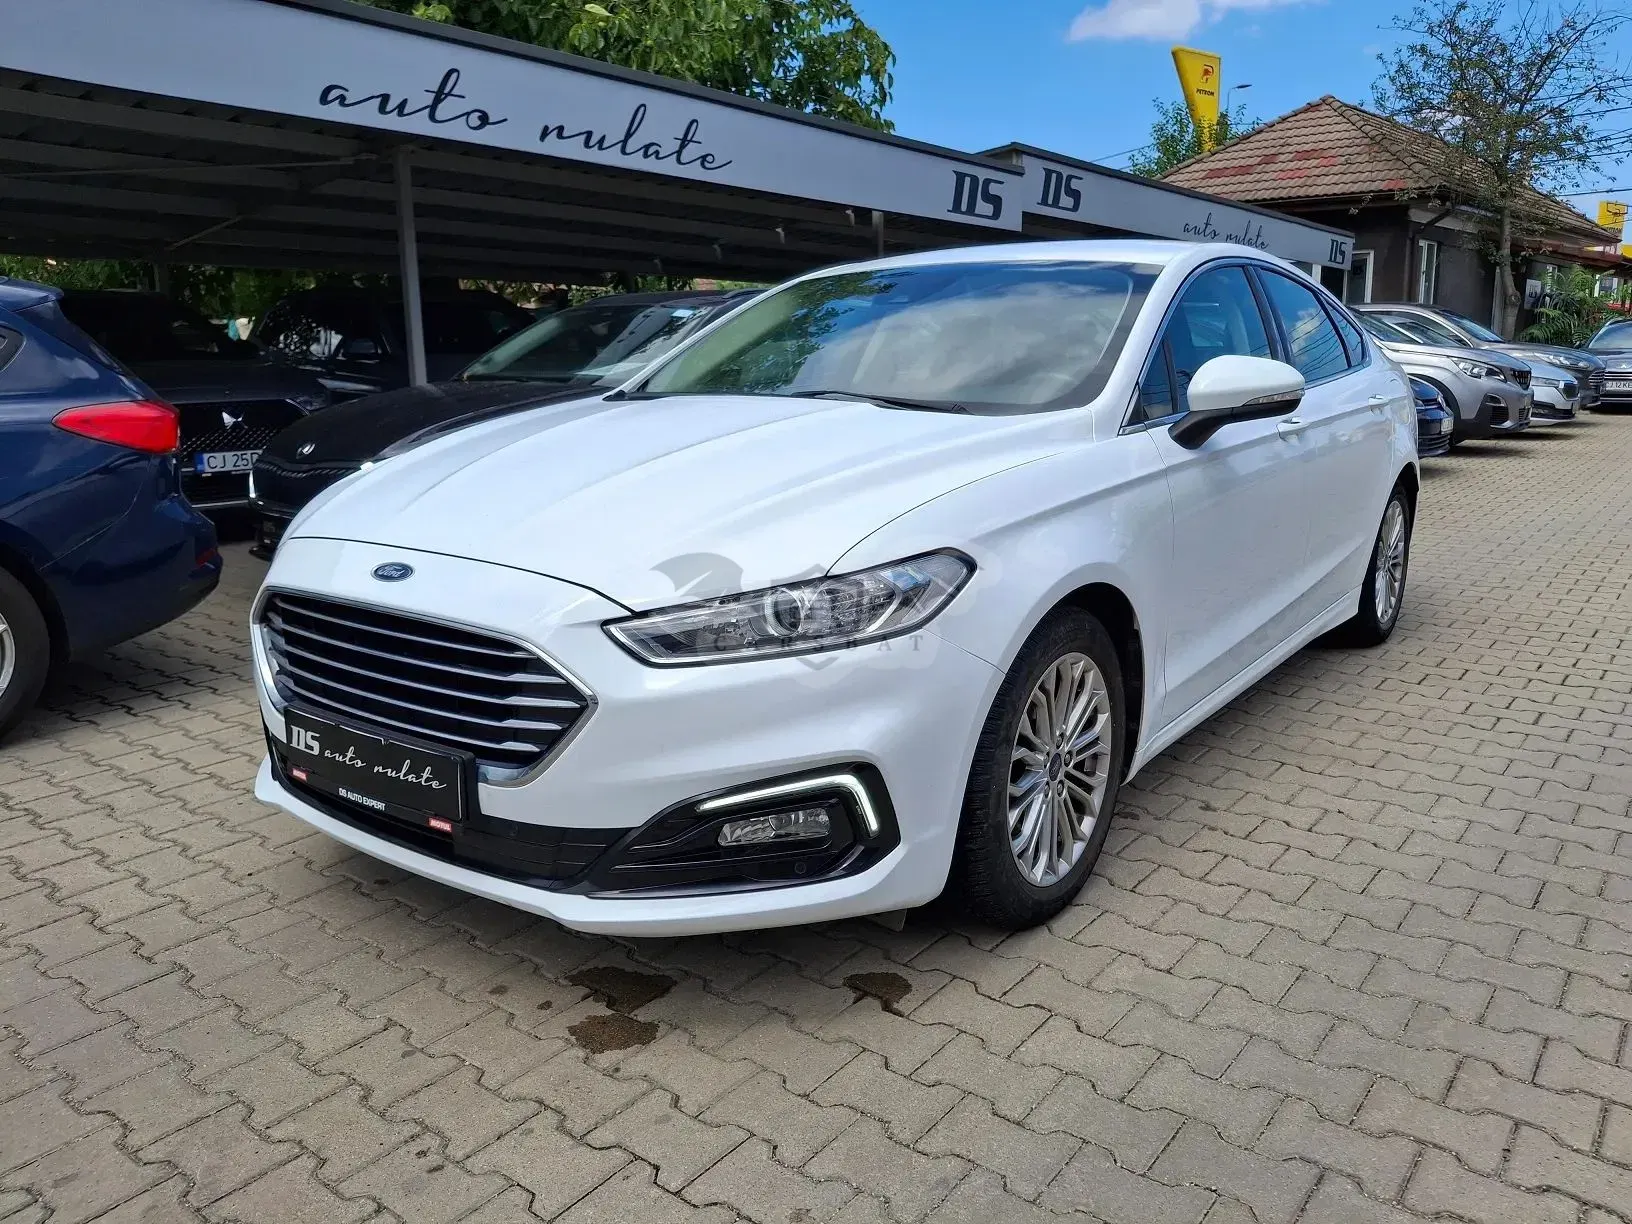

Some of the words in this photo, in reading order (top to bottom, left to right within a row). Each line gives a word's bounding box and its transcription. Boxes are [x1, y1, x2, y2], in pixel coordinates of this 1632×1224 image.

[320, 68, 508, 131] auto
[539, 103, 732, 170] rulate
[947, 169, 1005, 221] DS
[1036, 167, 1084, 213] DS
[1183, 211, 1219, 240] auto
[1225, 219, 1269, 250] rulate
[1328, 238, 1347, 265] DS
[207, 454, 226, 469] CJ
[377, 565, 406, 578] Ford
[289, 724, 321, 756] DS
[324, 745, 367, 769] auto
[373, 759, 447, 790] rulate
[339, 787, 347, 798] DS
[347, 791, 362, 803] AUTO
[363, 796, 386, 811] EXPERT
